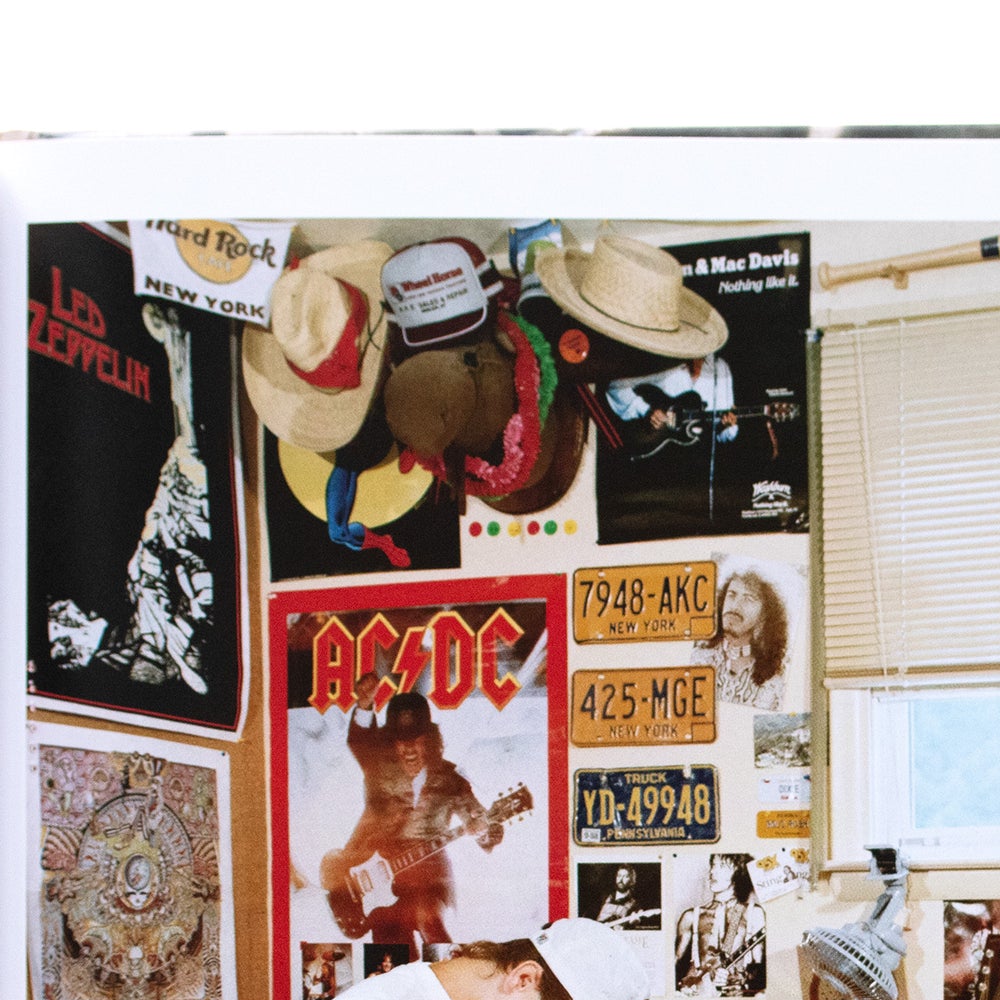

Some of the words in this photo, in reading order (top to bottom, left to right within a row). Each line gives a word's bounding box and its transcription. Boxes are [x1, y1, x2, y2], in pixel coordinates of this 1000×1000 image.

[215, 228, 276, 267] Rock
[695, 257, 708, 275] &
[711, 256, 746, 274] Mac
[749, 248, 799, 270] Davis
[52, 265, 106, 339] LED
[145, 275, 198, 304] NEW
[205, 295, 265, 319] YORK
[718, 278, 763, 295] Nothing
[766, 275, 786, 289] like
[27, 299, 151, 403] ZEPPELIN
[580, 575, 709, 619] 7948-AKC
[609, 621, 637, 635] NEW
[643, 619, 676, 632] YORK
[580, 676, 707, 720] 425-MGE
[609, 725, 640, 738] NEW
[643, 724, 679, 737] YORK
[624, 772, 667, 785] TRUCK
[583, 783, 710, 827] YD-49948
[606, 827, 686, 840] PENNSYLVANIA
